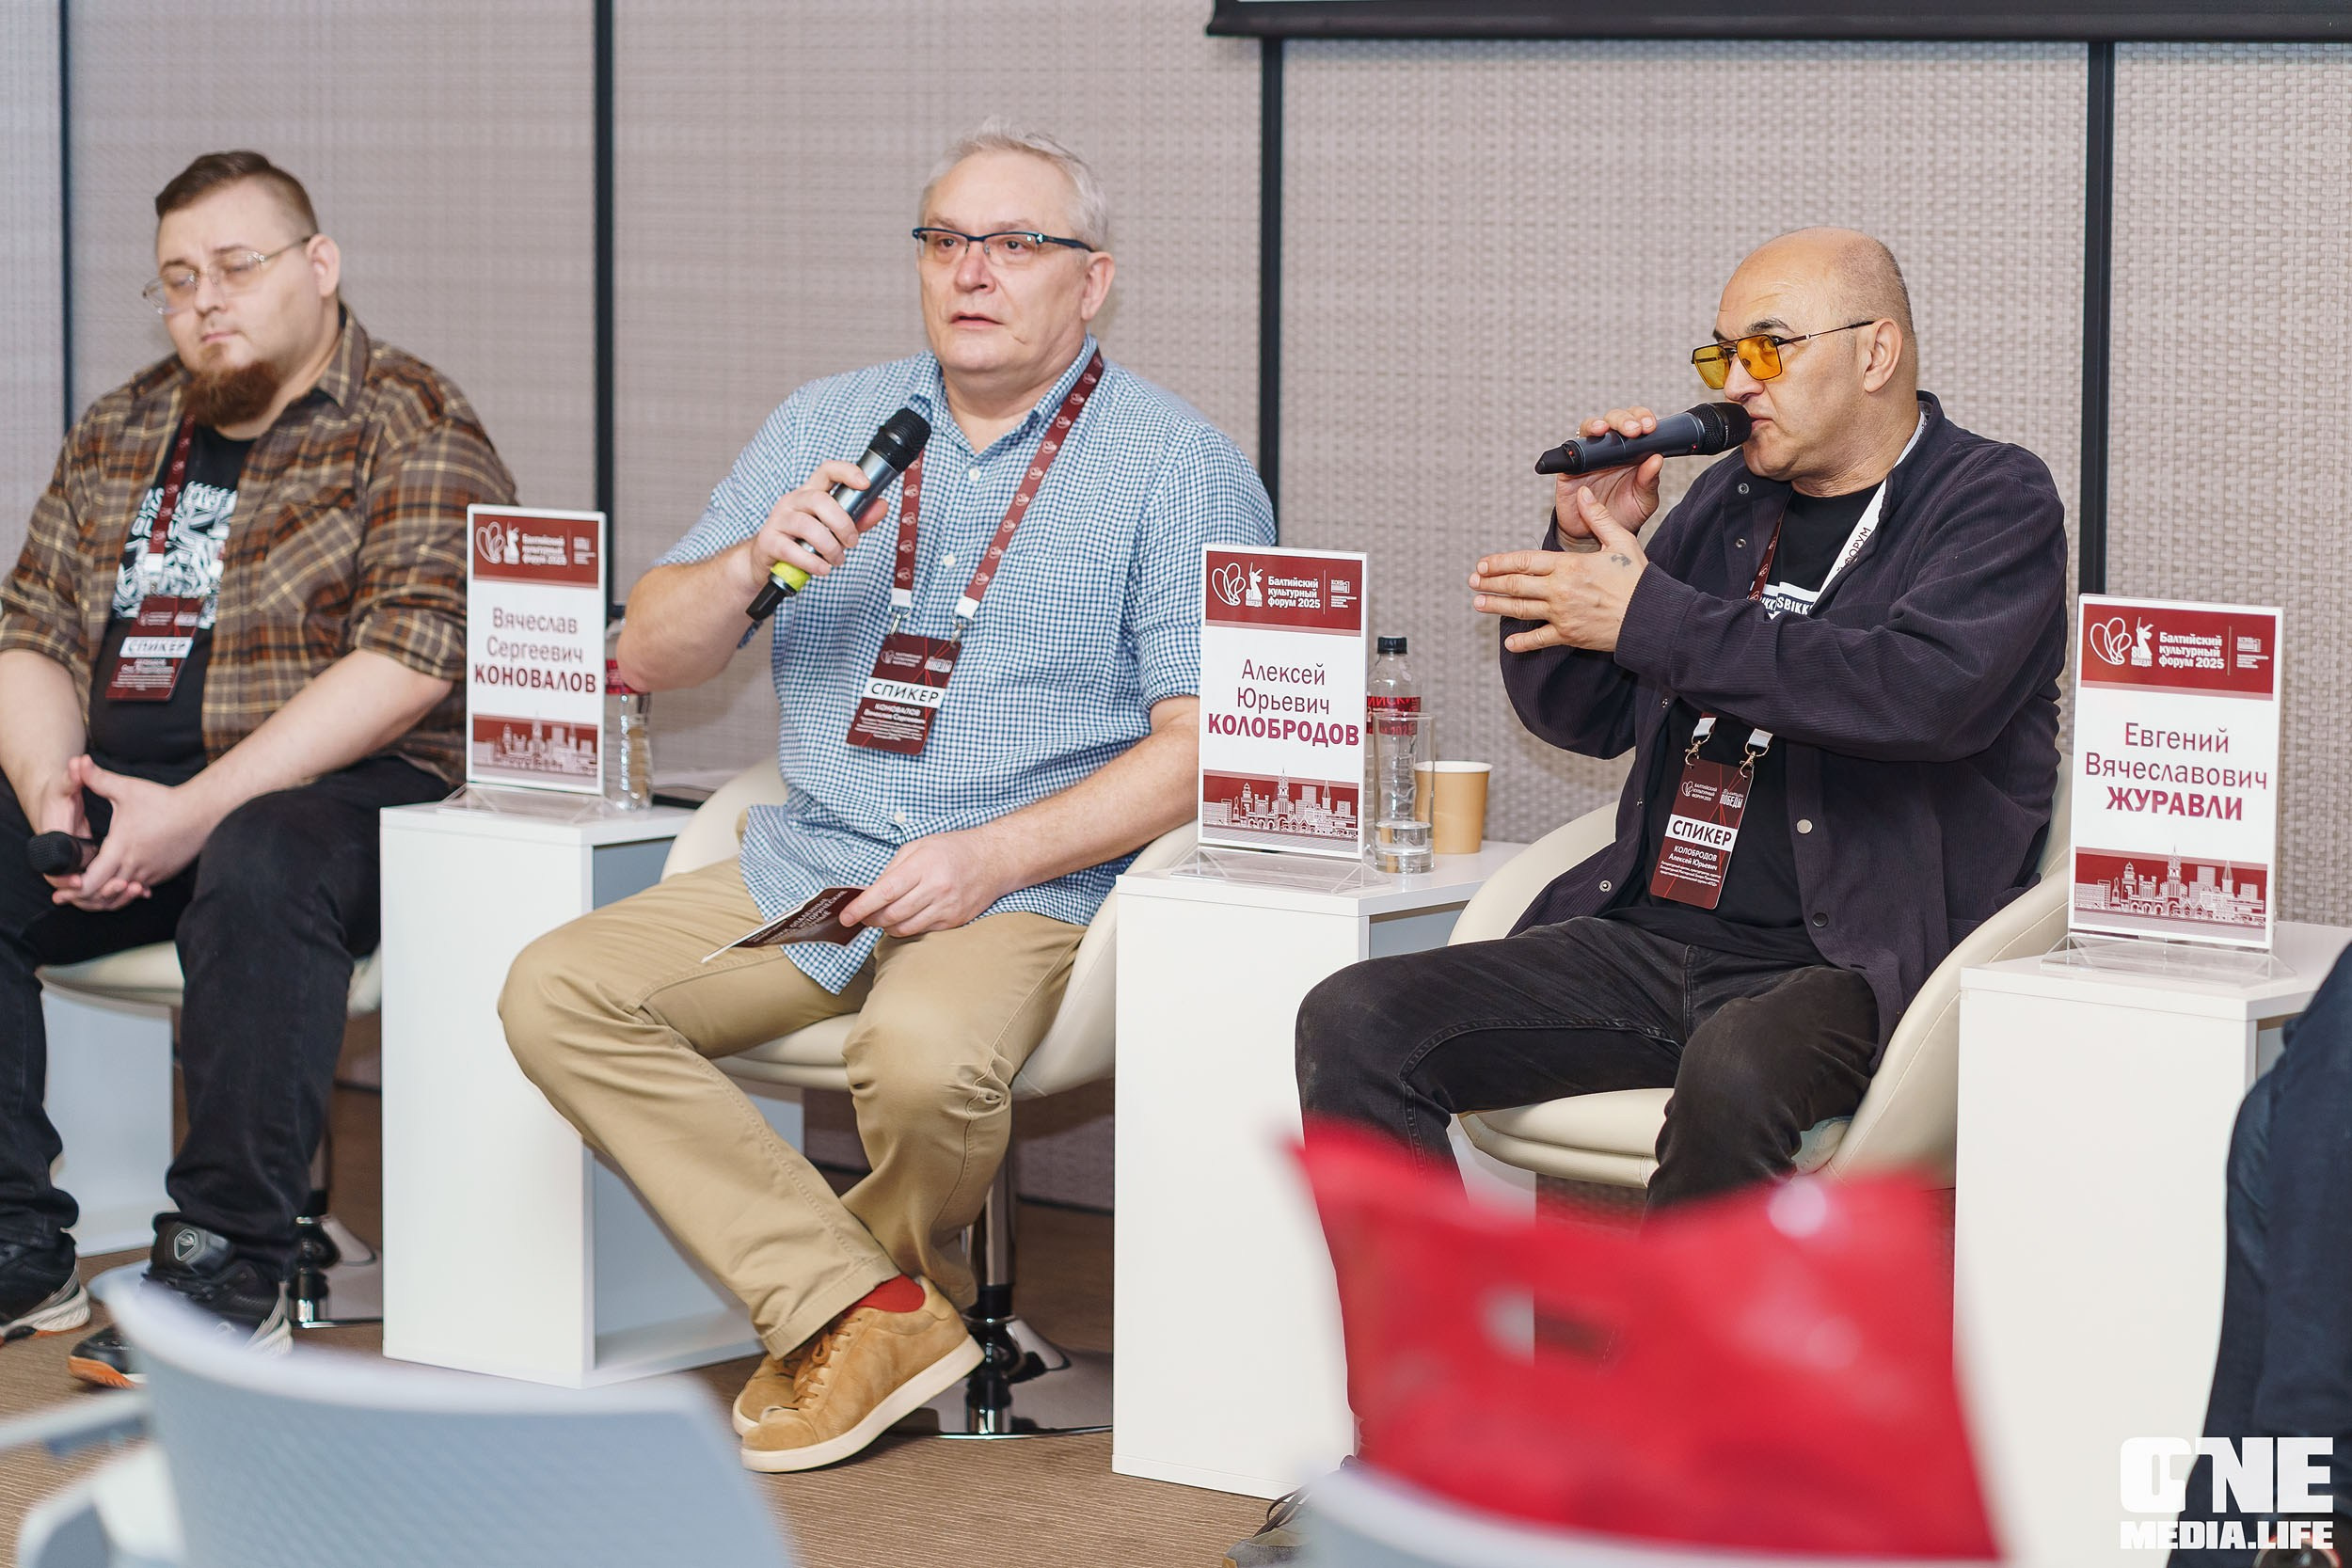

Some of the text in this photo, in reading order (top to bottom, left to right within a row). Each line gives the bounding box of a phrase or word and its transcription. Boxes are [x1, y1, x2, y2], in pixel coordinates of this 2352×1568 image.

[1268, 576, 1319, 588] Балтийский
[1268, 588, 1317, 599] культурный
[1267, 596, 1296, 609] форум
[1297, 597, 1321, 609] 2025
[493, 607, 579, 634] Вячеслав
[486, 635, 584, 664] Сергеевич
[2158, 645, 2221, 658] культурный
[2159, 631, 2222, 647] Балтийский
[1242, 659, 1326, 687] Алексей
[2158, 655, 2194, 669] форум
[2195, 656, 2225, 670] 2025
[474, 663, 596, 694] КОНОВАЛОВ
[871, 682, 939, 704] СПИКЕР
[1237, 687, 1329, 715] Юрьевич
[1208, 713, 1359, 749] КОЛОБРОДОВ
[2125, 721, 2229, 753] Евгений
[2086, 752, 2267, 790] Вячеславович
[2106, 785, 2243, 821] ЖУРАВЛИ
[1673, 819, 1732, 846] СПИКЕР
[1668, 853, 1718, 871] Алексей Юрьевич
[1674, 845, 1718, 862] КОЛОБРОДОВ
